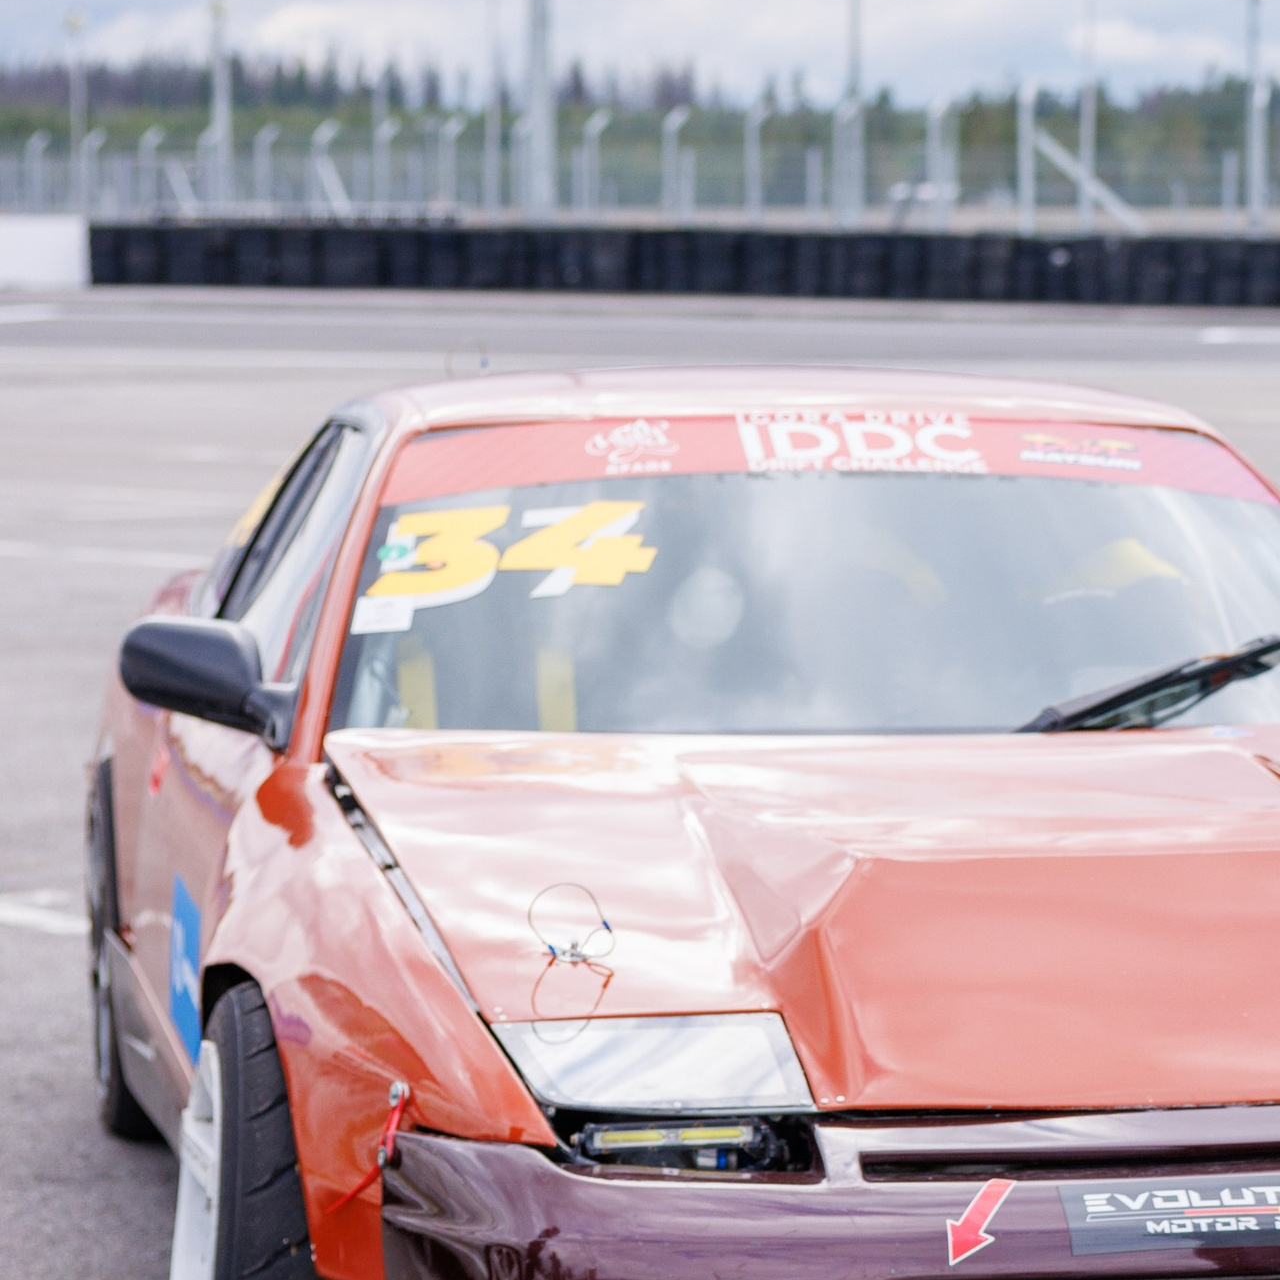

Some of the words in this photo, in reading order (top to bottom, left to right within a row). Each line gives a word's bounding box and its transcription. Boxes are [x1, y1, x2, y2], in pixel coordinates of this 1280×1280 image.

[865, 411, 970, 428] DRIVE
[738, 421, 982, 462] IDDC
[364, 499, 658, 597] 34
[1146, 1216, 1261, 1235] MOTOR
